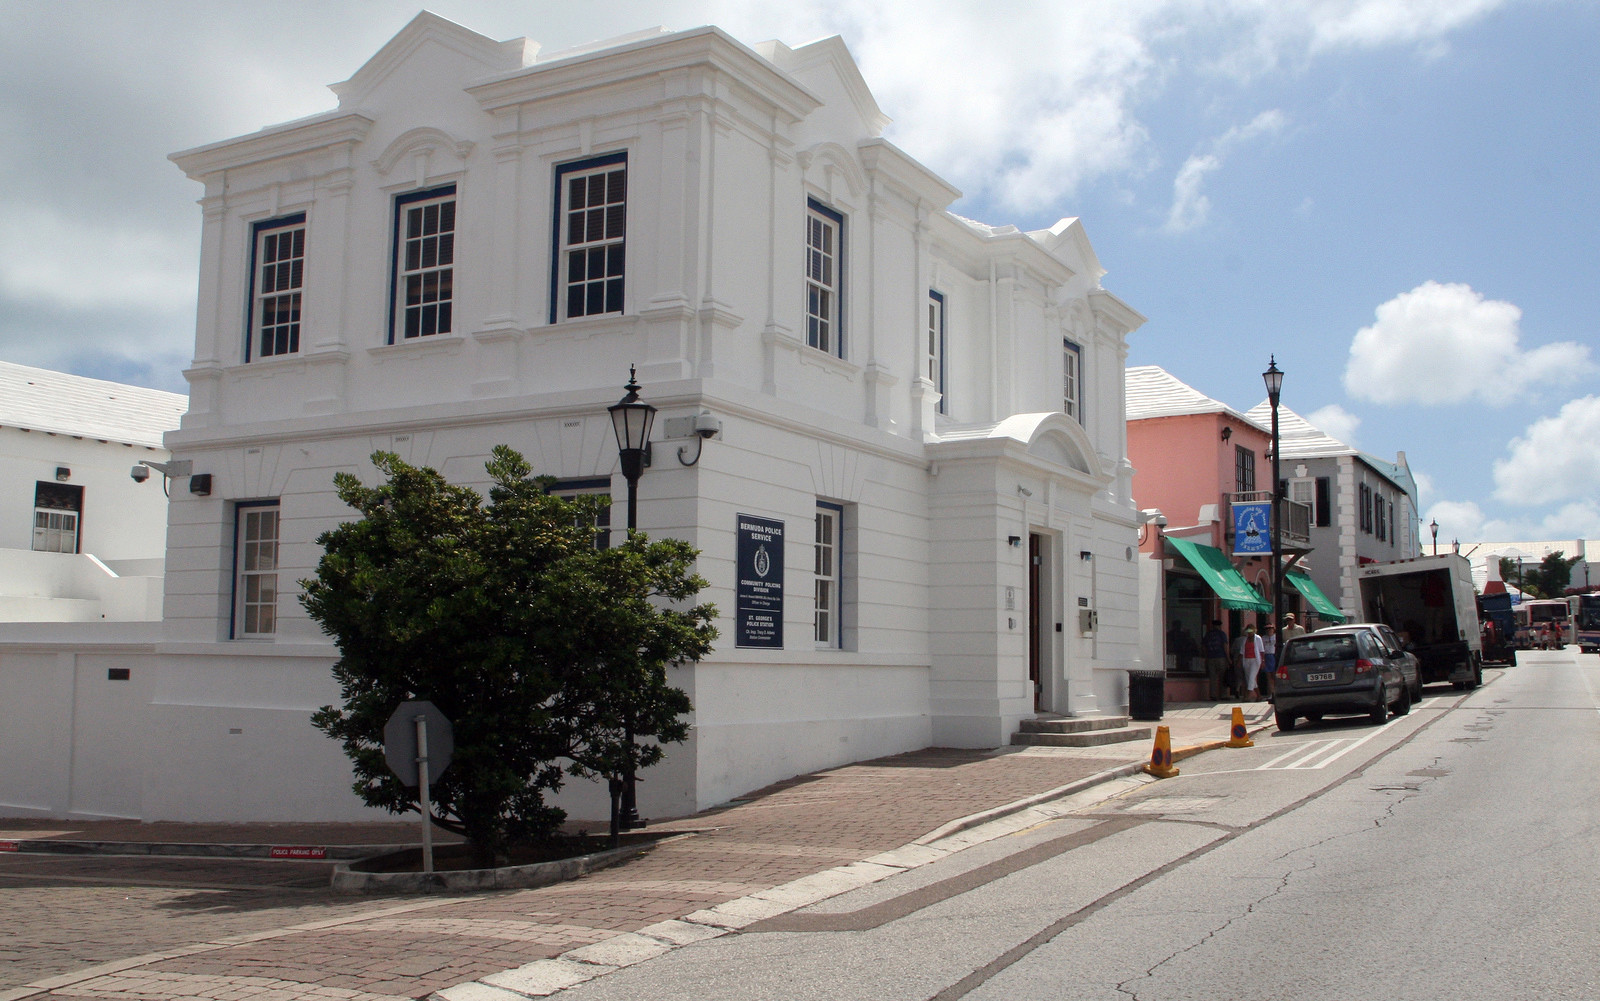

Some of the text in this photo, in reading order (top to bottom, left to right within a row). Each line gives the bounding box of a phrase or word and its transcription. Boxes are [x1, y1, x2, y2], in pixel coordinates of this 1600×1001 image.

[740, 522, 782, 536] BERMUDA POLICE
[752, 532, 772, 542] SERVICE
